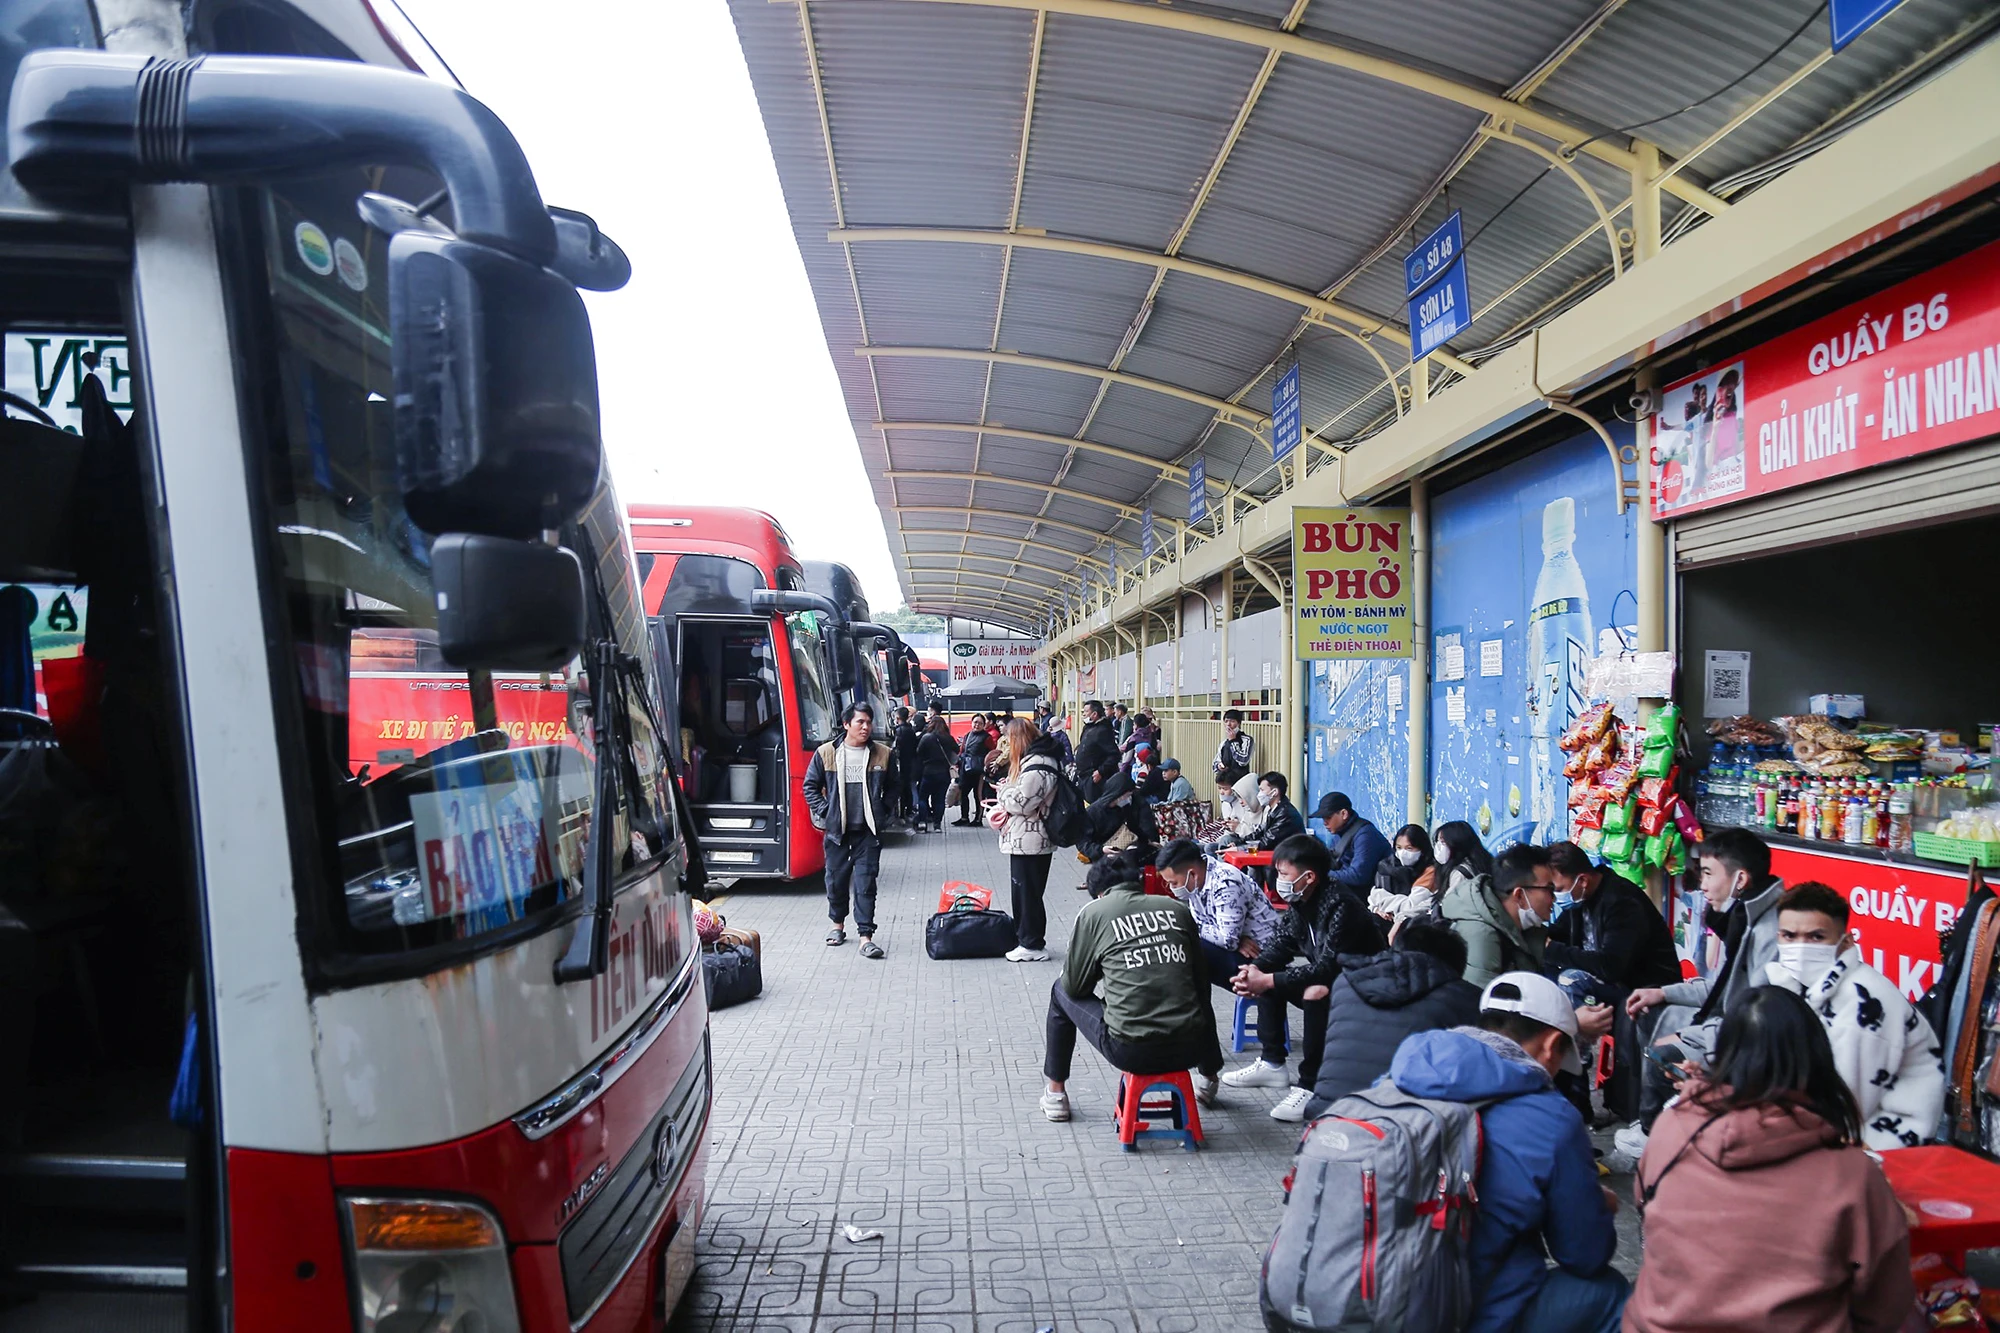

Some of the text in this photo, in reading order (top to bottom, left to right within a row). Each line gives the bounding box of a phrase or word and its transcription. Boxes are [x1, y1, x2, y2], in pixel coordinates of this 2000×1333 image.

[1427, 235, 1453, 272] SỐ 48
[1419, 284, 1455, 328] SƠN LA
[1808, 293, 1949, 376] QUẦY B6
[1758, 399, 1797, 476] GIẢI
[1803, 386, 1859, 463] KHÁT
[1882, 367, 1918, 441] ĂN
[1302, 514, 1401, 552] BÚN
[1305, 557, 1401, 599] PHỞ
[1300, 605, 1318, 618] MỲ
[1319, 604, 1345, 618] TÔM
[1355, 604, 1386, 618] BÁNH
[1389, 604, 1406, 617] MỲ
[1320, 622, 1388, 636] NƯỚC NGỌT
[1309, 638, 1401, 653] THẺ ĐIỆN THOẠI
[378, 720, 404, 739] XE
[406, 720, 428, 739] ĐI
[431, 714, 460, 740] VỀ
[1111, 910, 1182, 942] INFUSE
[1849, 885, 1965, 933] QUẦY B
[1123, 943, 1186, 969] EST 1986
[1138, 934, 1167, 945] NEW YORK
[1899, 954, 1944, 1002] K
